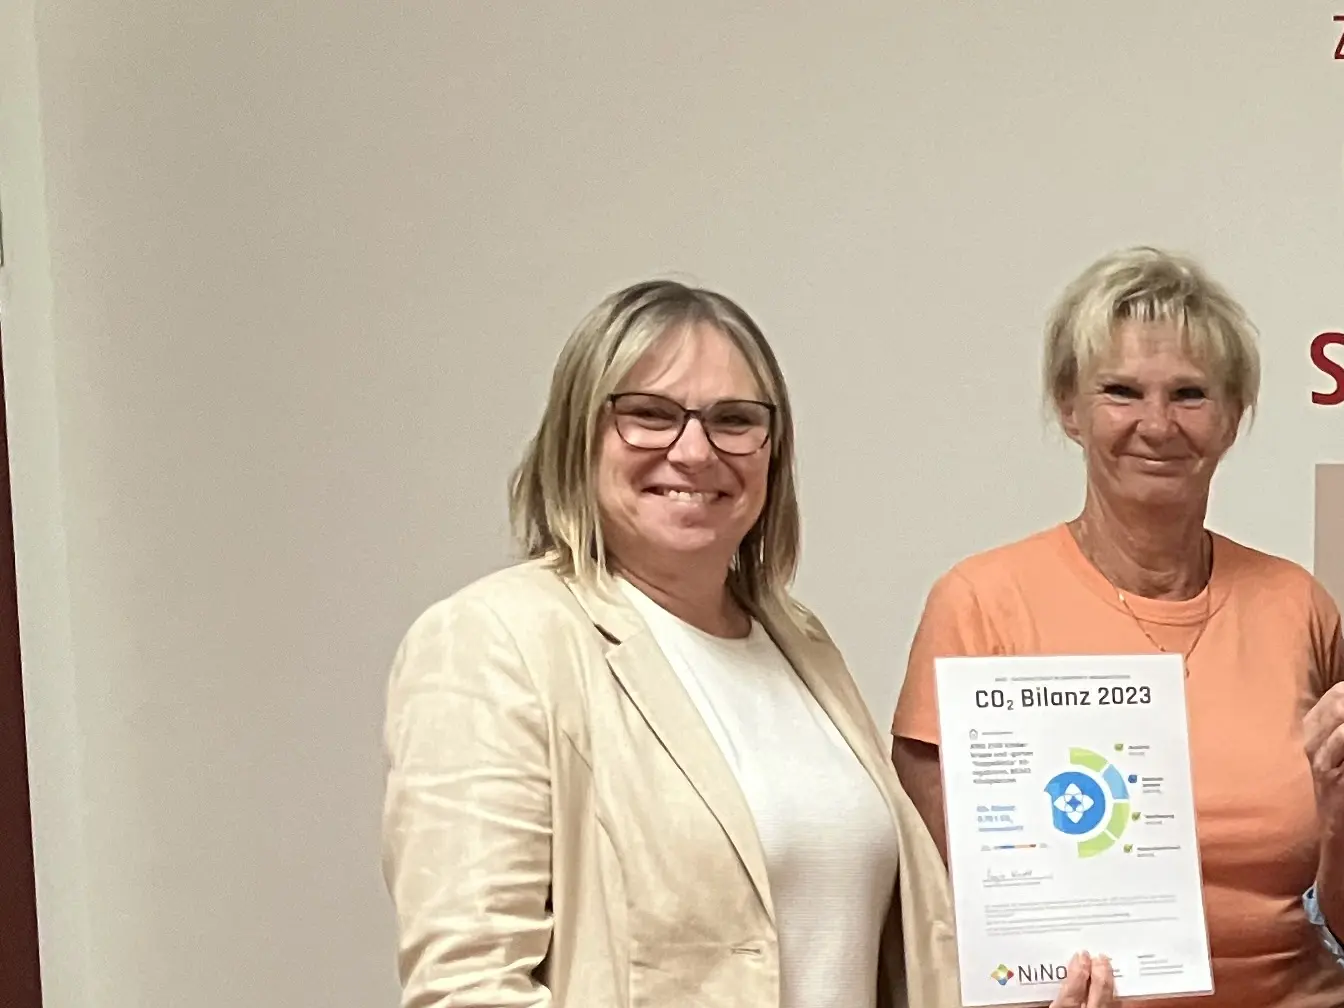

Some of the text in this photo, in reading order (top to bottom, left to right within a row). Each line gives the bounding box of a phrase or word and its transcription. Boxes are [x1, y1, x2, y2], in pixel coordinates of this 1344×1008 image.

[1021, 686, 1091, 708] Bilanz
[1097, 685, 1151, 706] 2023
[1017, 963, 1068, 983] NiNo
